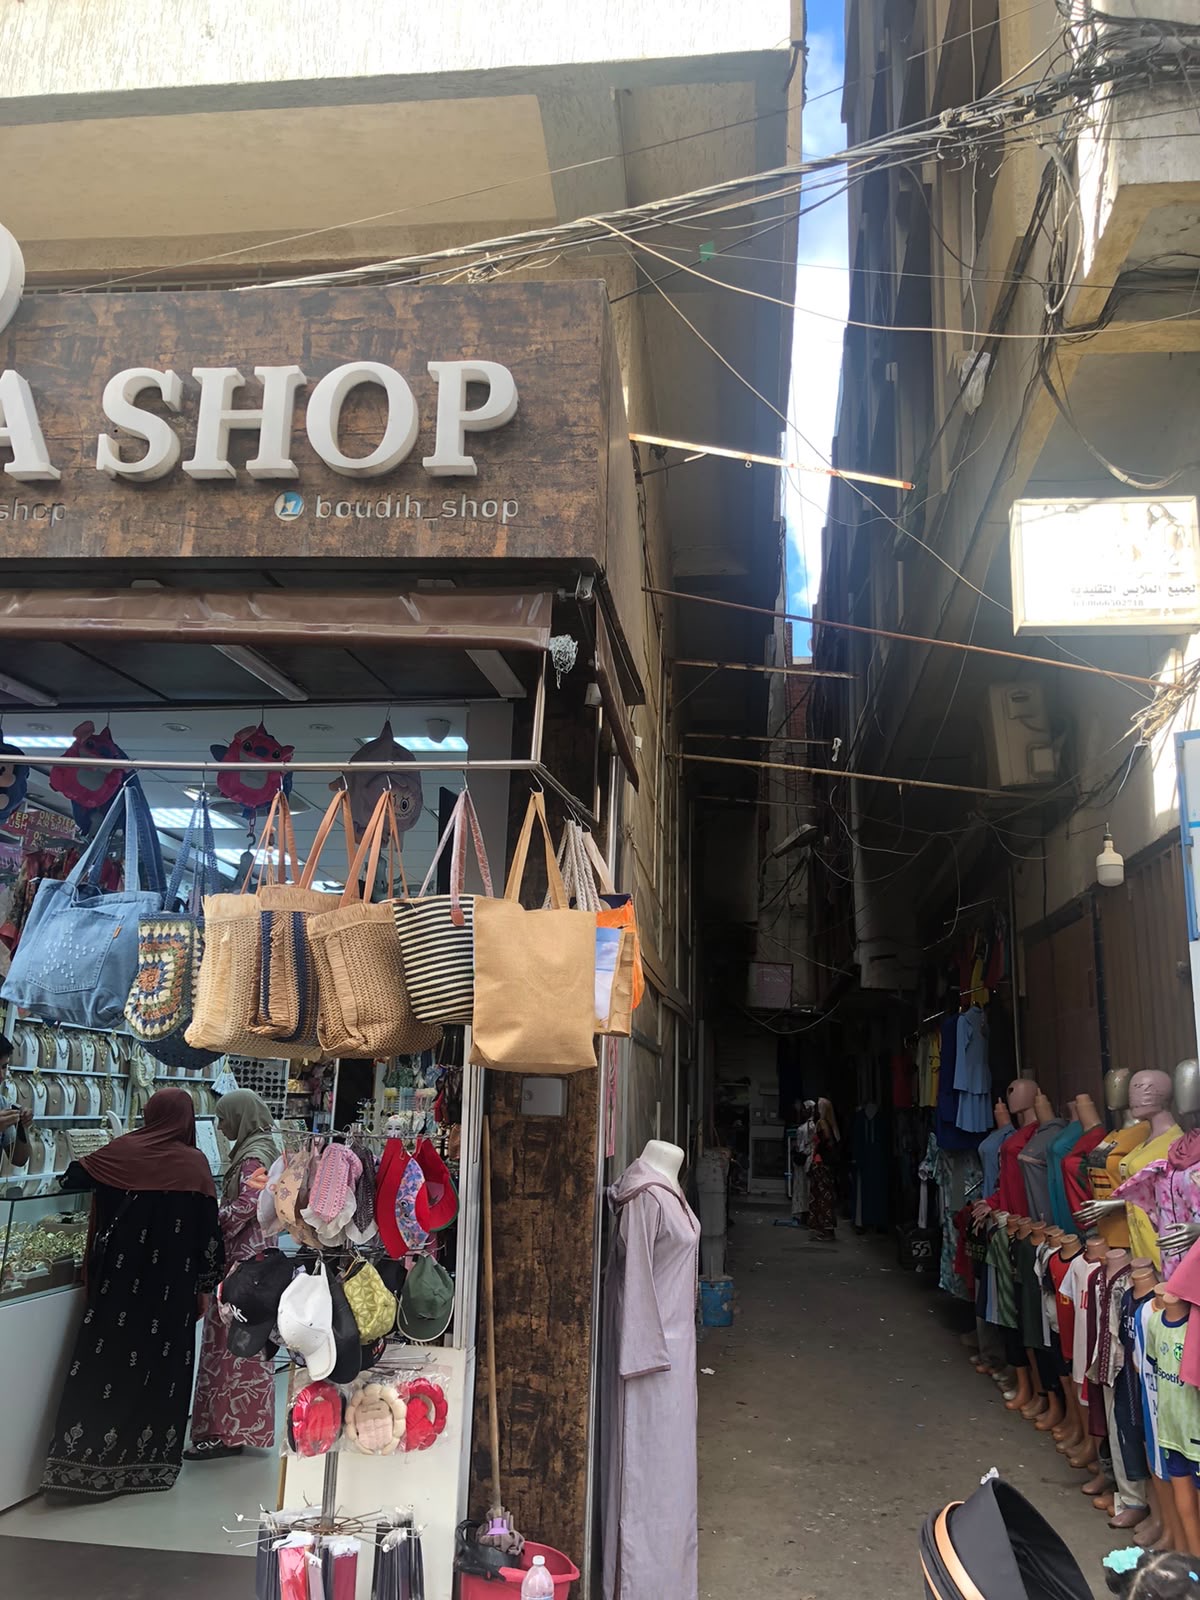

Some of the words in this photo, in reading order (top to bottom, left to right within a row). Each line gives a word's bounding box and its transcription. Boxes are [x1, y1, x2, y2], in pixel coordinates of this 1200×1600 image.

[96, 360, 518, 482] SHOP
[314, 492, 520, 525] boudih_shop
[1122, 584, 1162, 597] الملابس
[1157, 1367, 1185, 1387] Spotify
